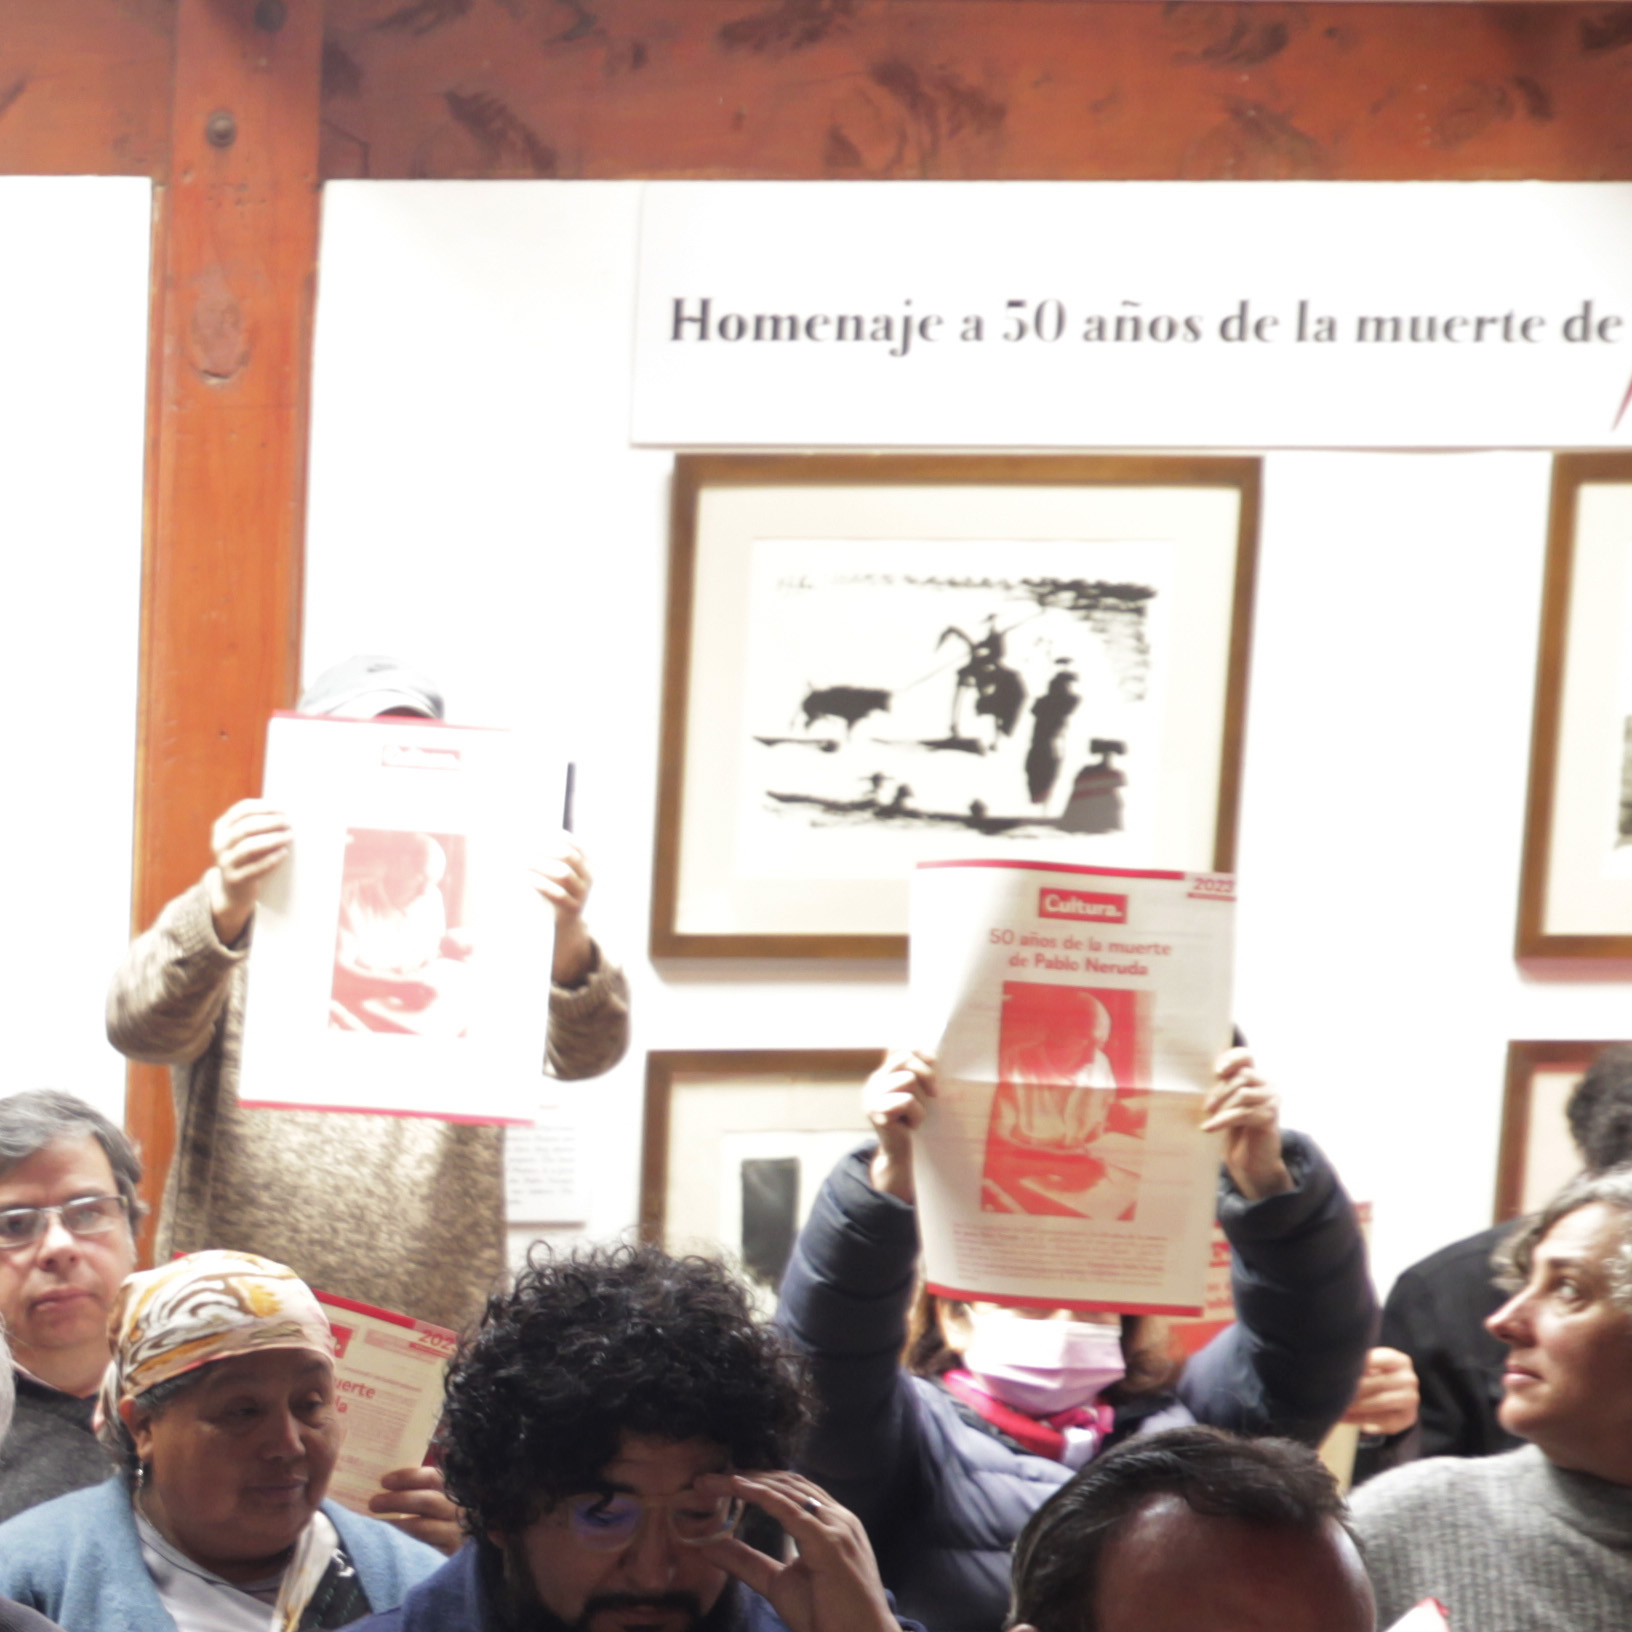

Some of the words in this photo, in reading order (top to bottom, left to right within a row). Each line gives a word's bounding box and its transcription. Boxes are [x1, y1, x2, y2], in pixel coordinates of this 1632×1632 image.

[670, 297, 943, 357] Homenaje
[959, 313, 984, 342] a
[1002, 298, 1067, 342] 50
[1082, 299, 1204, 343] años
[1218, 298, 1280, 343] de
[1294, 298, 1337, 343] la
[1354, 308, 1546, 343] muerte
[1561, 298, 1624, 343] de
[1193, 877, 1235, 894] 2023
[1044, 894, 1123, 917] Cultura.
[988, 928, 1016, 946] 50
[1019, 930, 1057, 948] años
[1062, 933, 1084, 951] de
[1088, 936, 1103, 952] la
[1108, 941, 1173, 956] muerte
[1008, 952, 1029, 969] de
[1034, 953, 1080, 972] Pablo
[1085, 957, 1150, 976] Neruda
